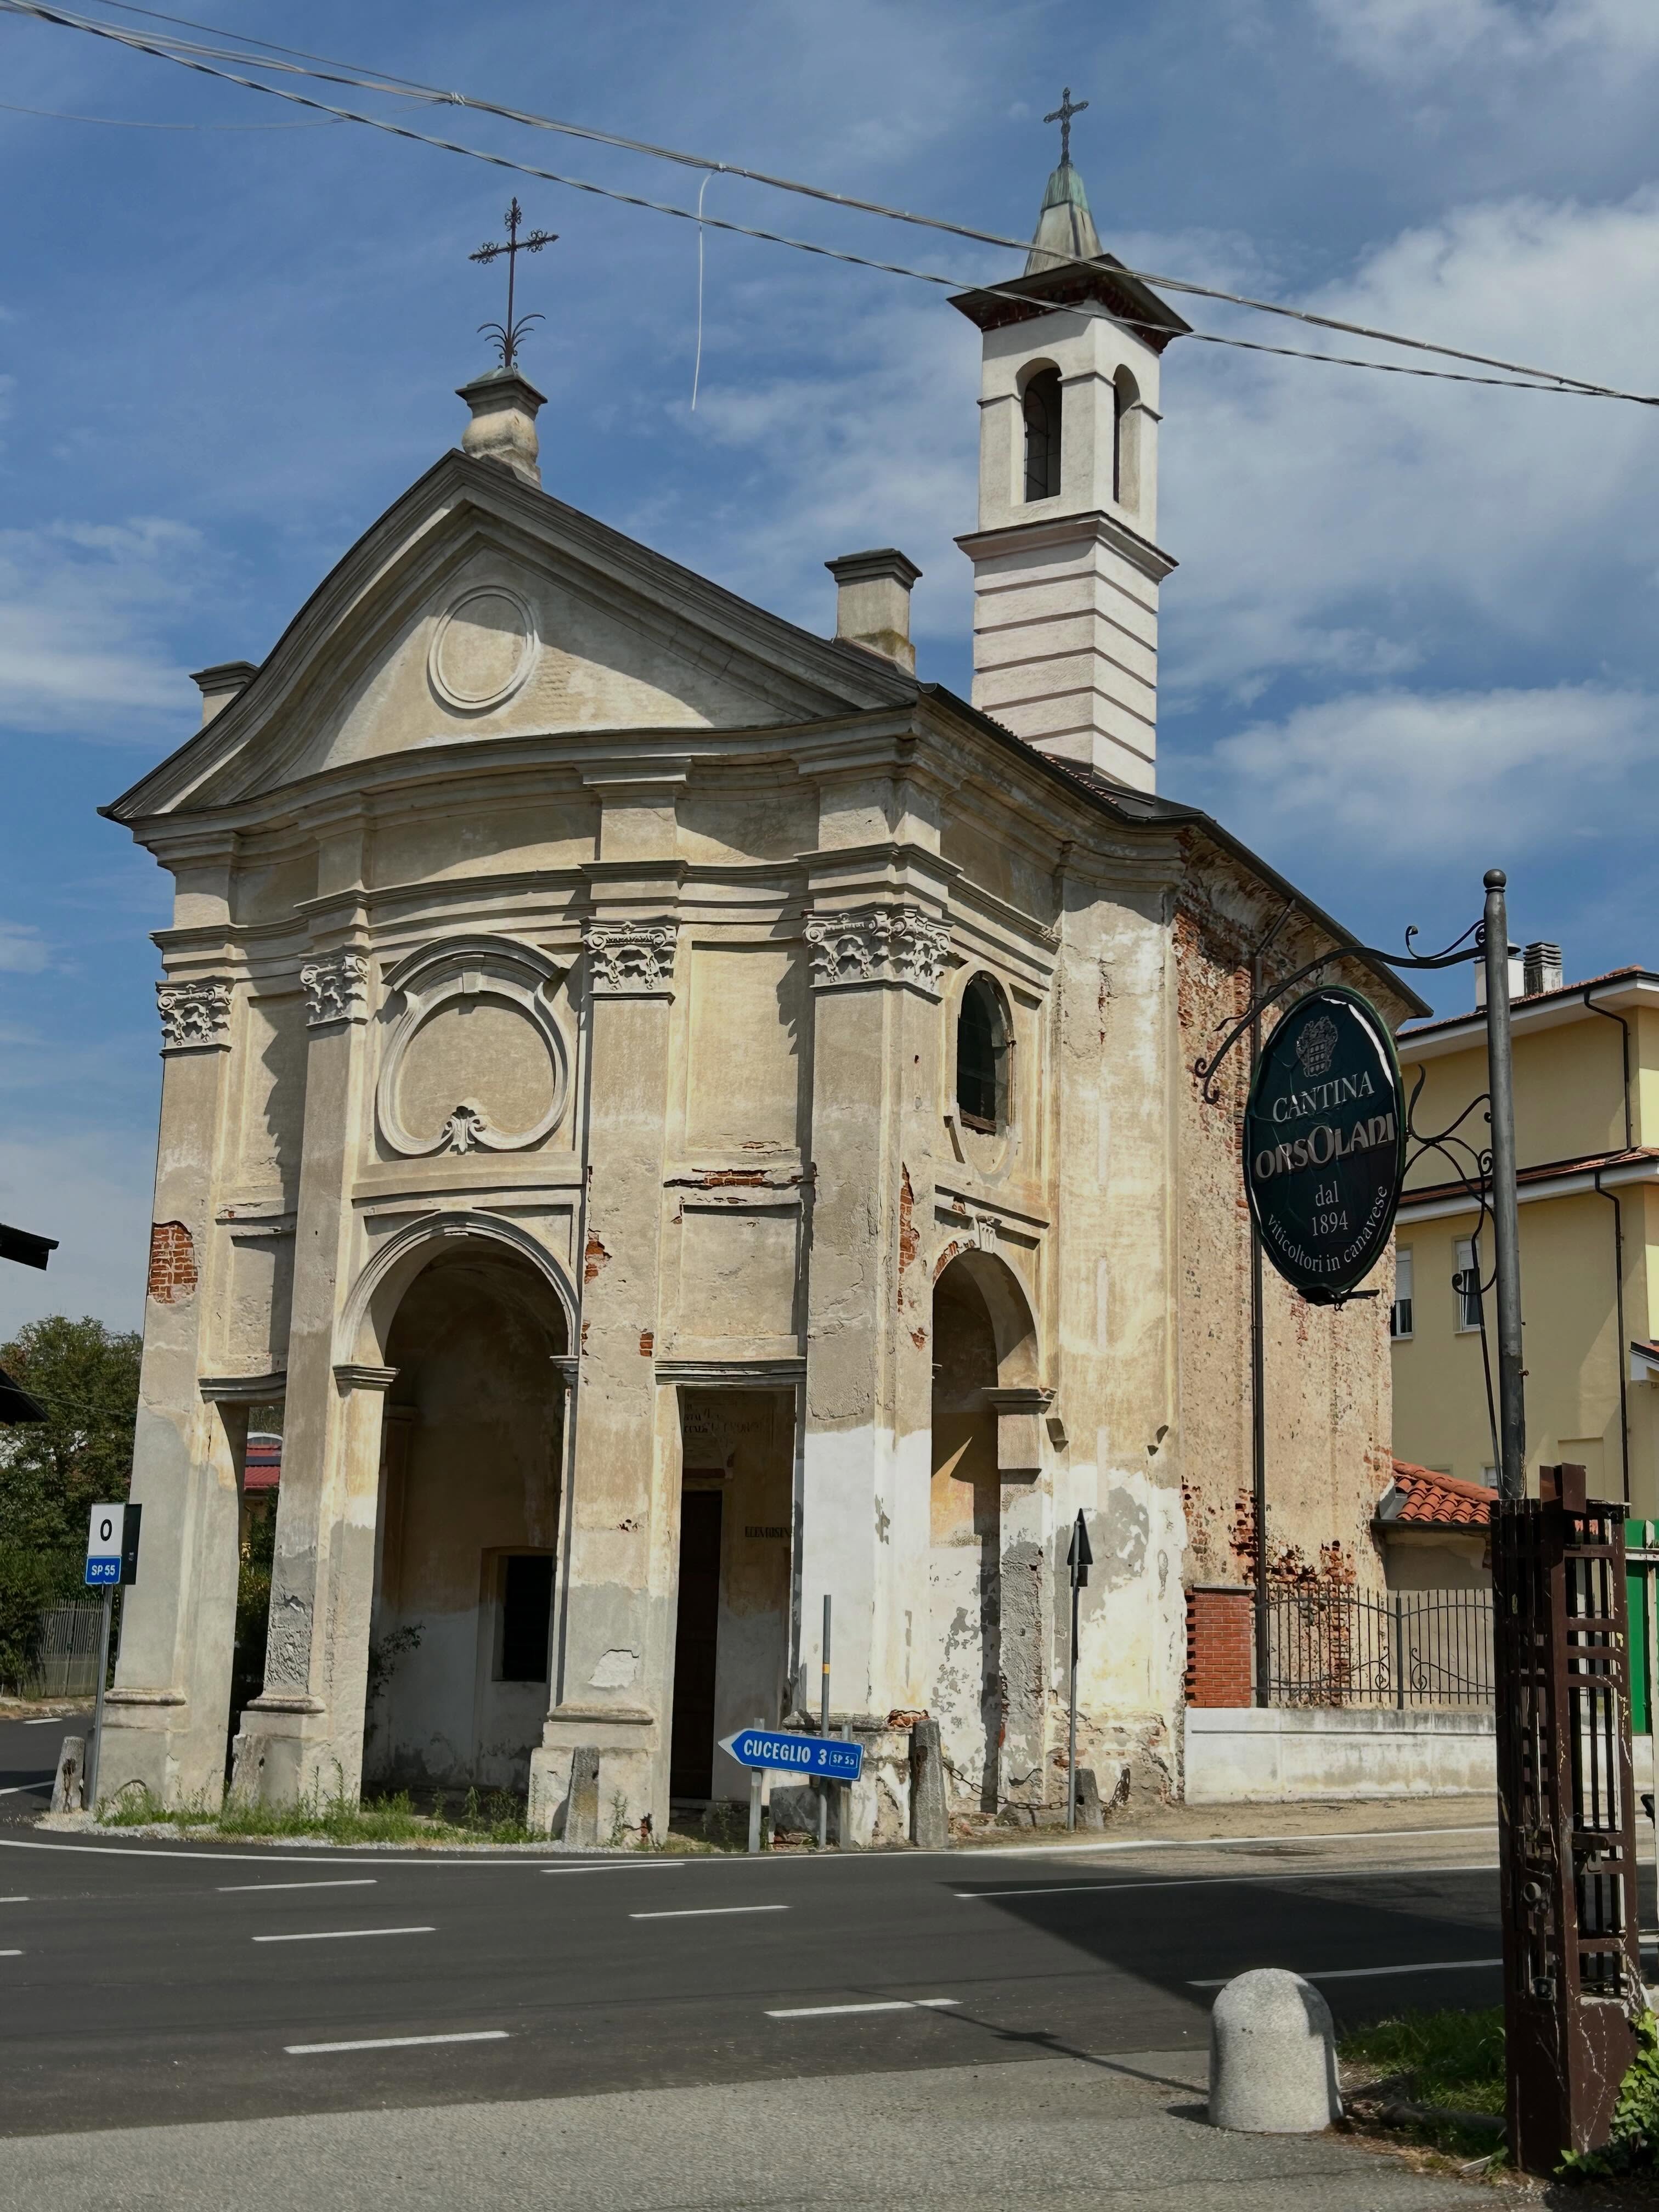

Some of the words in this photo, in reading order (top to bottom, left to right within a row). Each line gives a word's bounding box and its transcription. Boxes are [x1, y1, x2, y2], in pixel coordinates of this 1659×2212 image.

[1273, 1071, 1375, 1123] CANTINA
[1255, 1113, 1395, 1178] ORSOLANI
[1315, 1181, 1339, 1207] dal
[1268, 1214, 1323, 1272] viticoltori
[1327, 1254, 1341, 1272] in
[1344, 1186, 1387, 1263] canavese
[1312, 1210, 1348, 1236] 1894
[92, 1565, 103, 1576] SP
[105, 1565, 115, 1576] 55
[744, 1739, 811, 1763] CUCEGLIO
[818, 1749, 827, 1765] 3
[833, 1754, 843, 1764] SP
